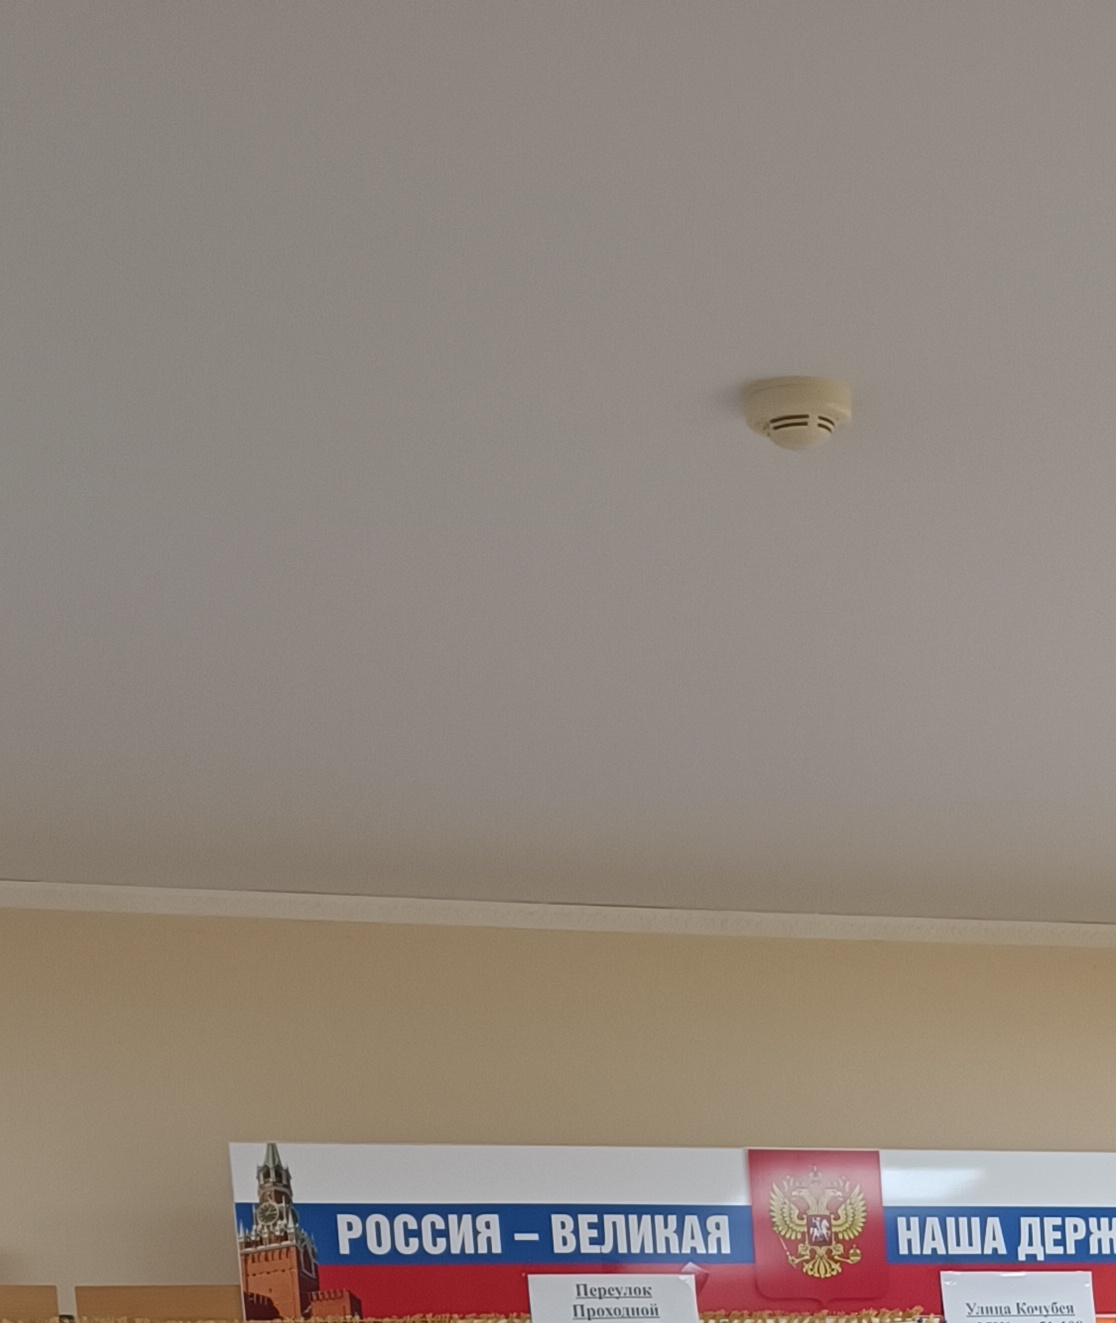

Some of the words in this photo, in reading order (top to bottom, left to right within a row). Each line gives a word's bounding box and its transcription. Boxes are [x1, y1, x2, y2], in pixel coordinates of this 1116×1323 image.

[336, 1214, 502, 1255] РОССИЯ
[551, 1214, 731, 1255] ВЕЛИКАЯ
[897, 1216, 1007, 1255] НАША
[576, 1283, 652, 1299] Переулок
[573, 1303, 660, 1320] Проходной
[965, 1302, 1012, 1316] Улица
[1016, 1302, 1074, 1317] Кочубея
